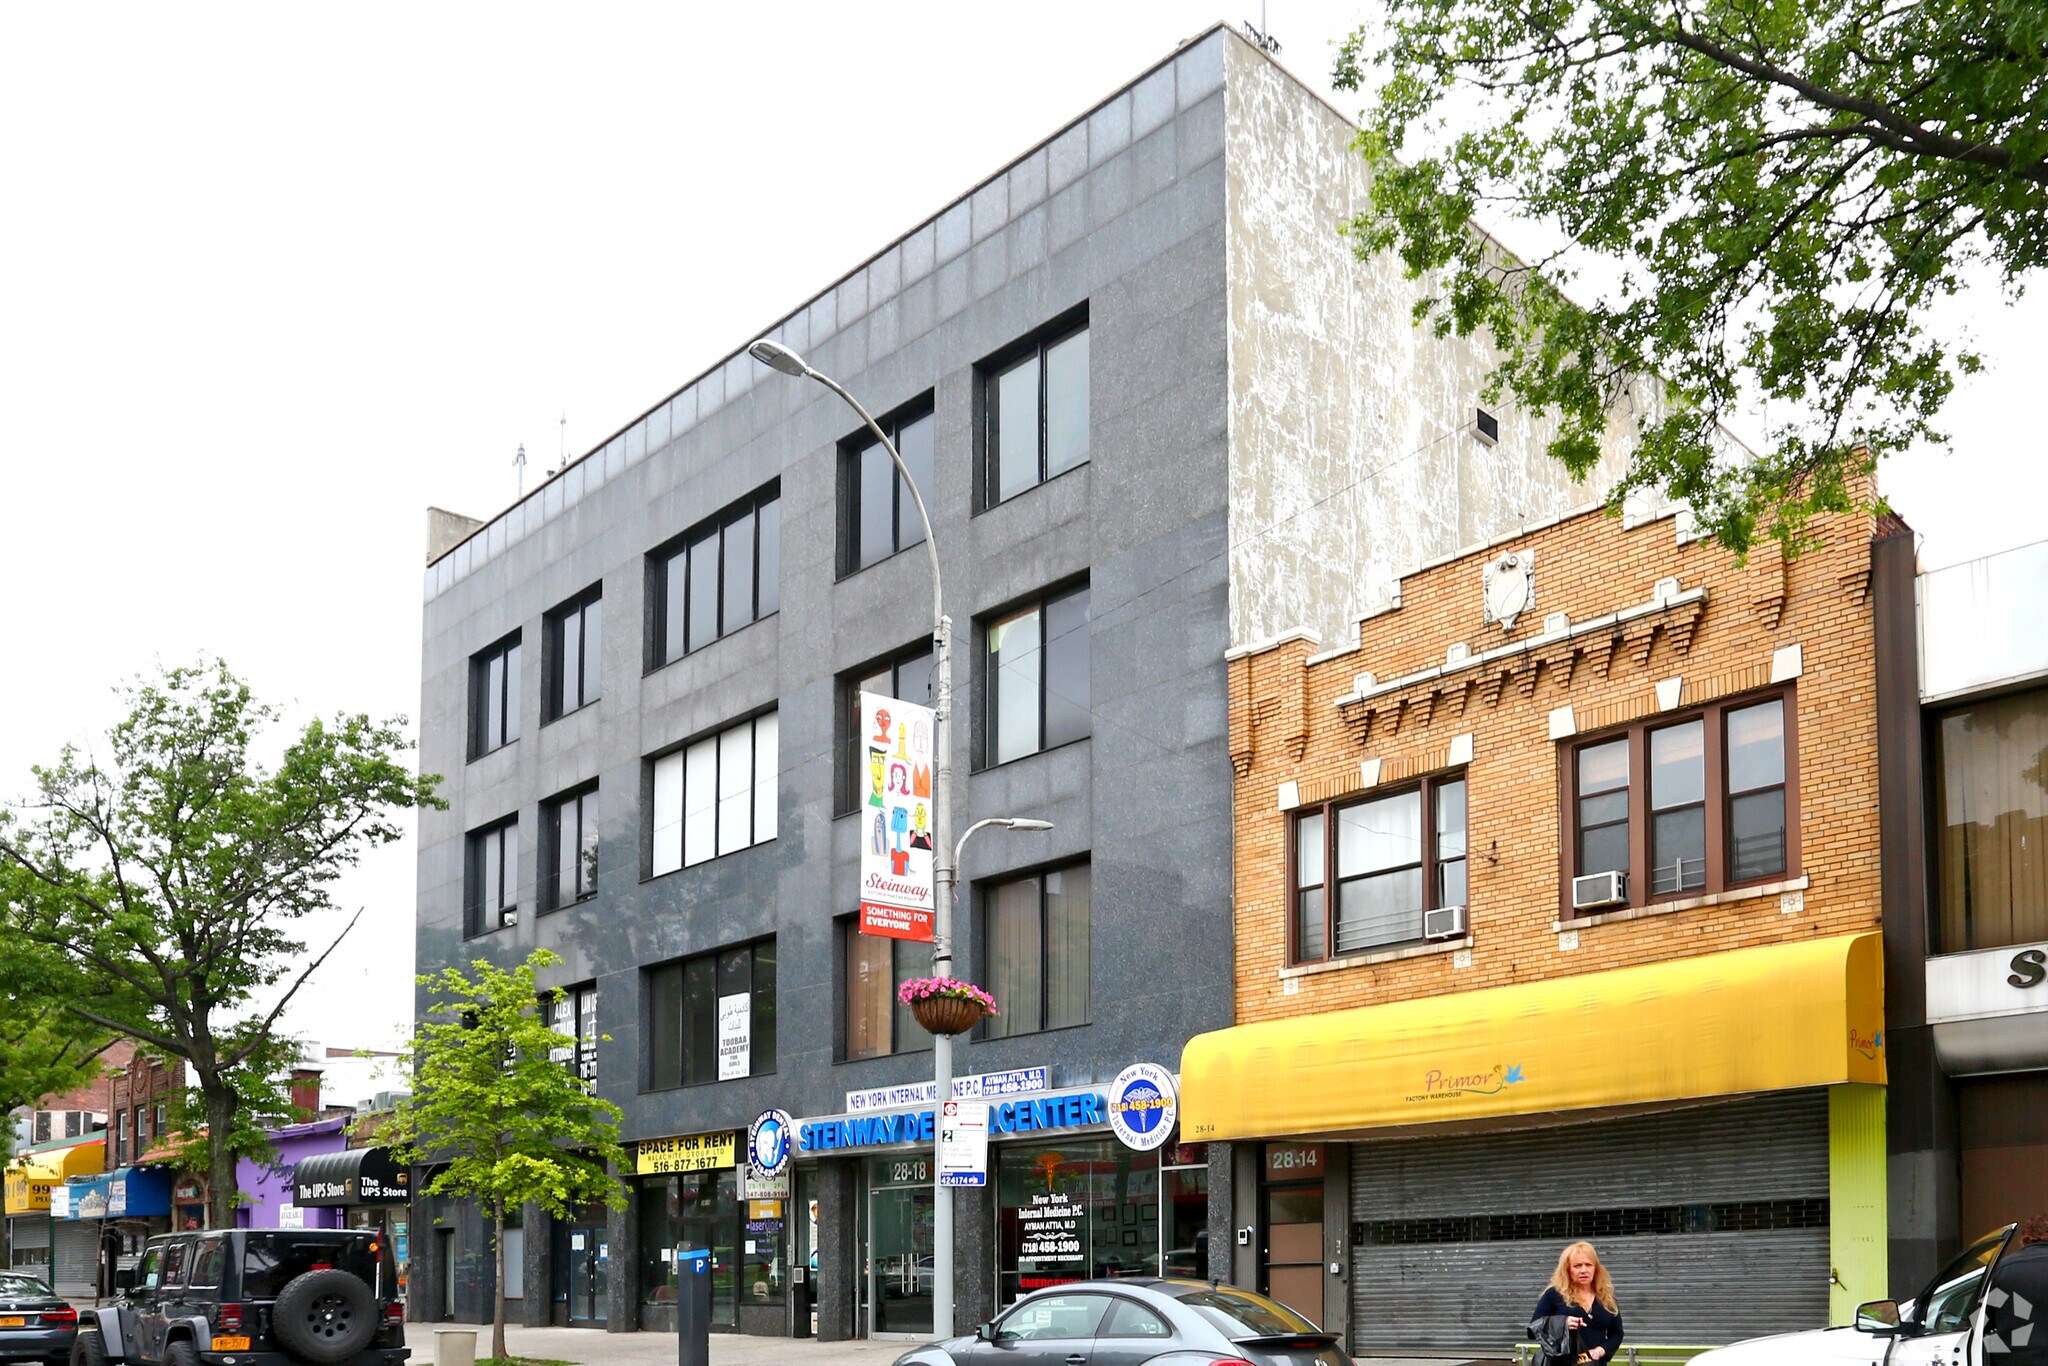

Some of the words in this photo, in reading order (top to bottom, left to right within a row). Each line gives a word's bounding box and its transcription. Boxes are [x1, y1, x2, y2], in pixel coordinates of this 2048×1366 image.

[866, 873, 931, 901] Steinway
[866, 906, 911, 920] SOMETHING
[914, 913, 928, 923] FOR
[866, 916, 910, 930] EVERYONE
[2007, 949, 2048, 988] S
[555, 1001, 572, 1020] ALEX
[722, 1036, 747, 1047] TOOBAA
[1850, 1029, 1874, 1049] Primor
[720, 1044, 749, 1056] ACADEMY
[985, 1075, 1007, 1086] AYMAN
[1029, 1070, 1043, 1080] M.D.
[1120, 1070, 1137, 1084] New
[1140, 1067, 1158, 1081] York
[1425, 1069, 1493, 1092] Primor
[850, 1093, 866, 1109] NEW
[868, 1091, 887, 1107] YORK
[889, 1086, 924, 1104] INTERNAL
[927, 1082, 963, 1100] MENE
[966, 1080, 980, 1096] P.C.
[983, 1085, 1000, 1095] (718)
[1001, 1079, 1043, 1092] 458-1900
[1430, 1092, 1462, 1100] WAREHOUSE
[1130, 1097, 1173, 1111] 458-1900
[749, 1111, 772, 1148] STEINWAY
[771, 1111, 790, 1140] DENTAL
[799, 1115, 900, 1152] STEINWAY
[998, 1093, 1101, 1133] CENTER
[1195, 1125, 1215, 1133] 28-14
[944, 1130, 952, 1142] 2
[1112, 1115, 1137, 1144] Internal
[1141, 1124, 1167, 1146] Medicine
[640, 1140, 673, 1155] SPACE
[678, 1138, 699, 1151] FOR
[704, 1133, 734, 1149] RENT
[647, 1152, 682, 1161] MALACHITE
[686, 1150, 710, 1158] GROUP
[1272, 1149, 1317, 1169] 28-14
[653, 1157, 718, 1172] 516-877-1677
[893, 1161, 926, 1181] 28-18
[361, 1177, 379, 1186] The
[941, 1176, 968, 1184] 424174
[299, 1185, 312, 1199] The
[312, 1183, 326, 1198] UPS
[327, 1182, 344, 1197] Store
[361, 1187, 380, 1197] UPS
[382, 1187, 407, 1197] Store
[1032, 1195, 1049, 1205] New
[1050, 1193, 1068, 1203] York
[1018, 1207, 1043, 1219] Internal
[1044, 1206, 1071, 1218] Medicine
[1072, 1204, 1084, 1216] P.C.
[1024, 1222, 1045, 1230] AYMAN
[1022, 1242, 1038, 1253] (718)
[1039, 1240, 1079, 1253] 458-1900
[696, 1260, 704, 1272] P
